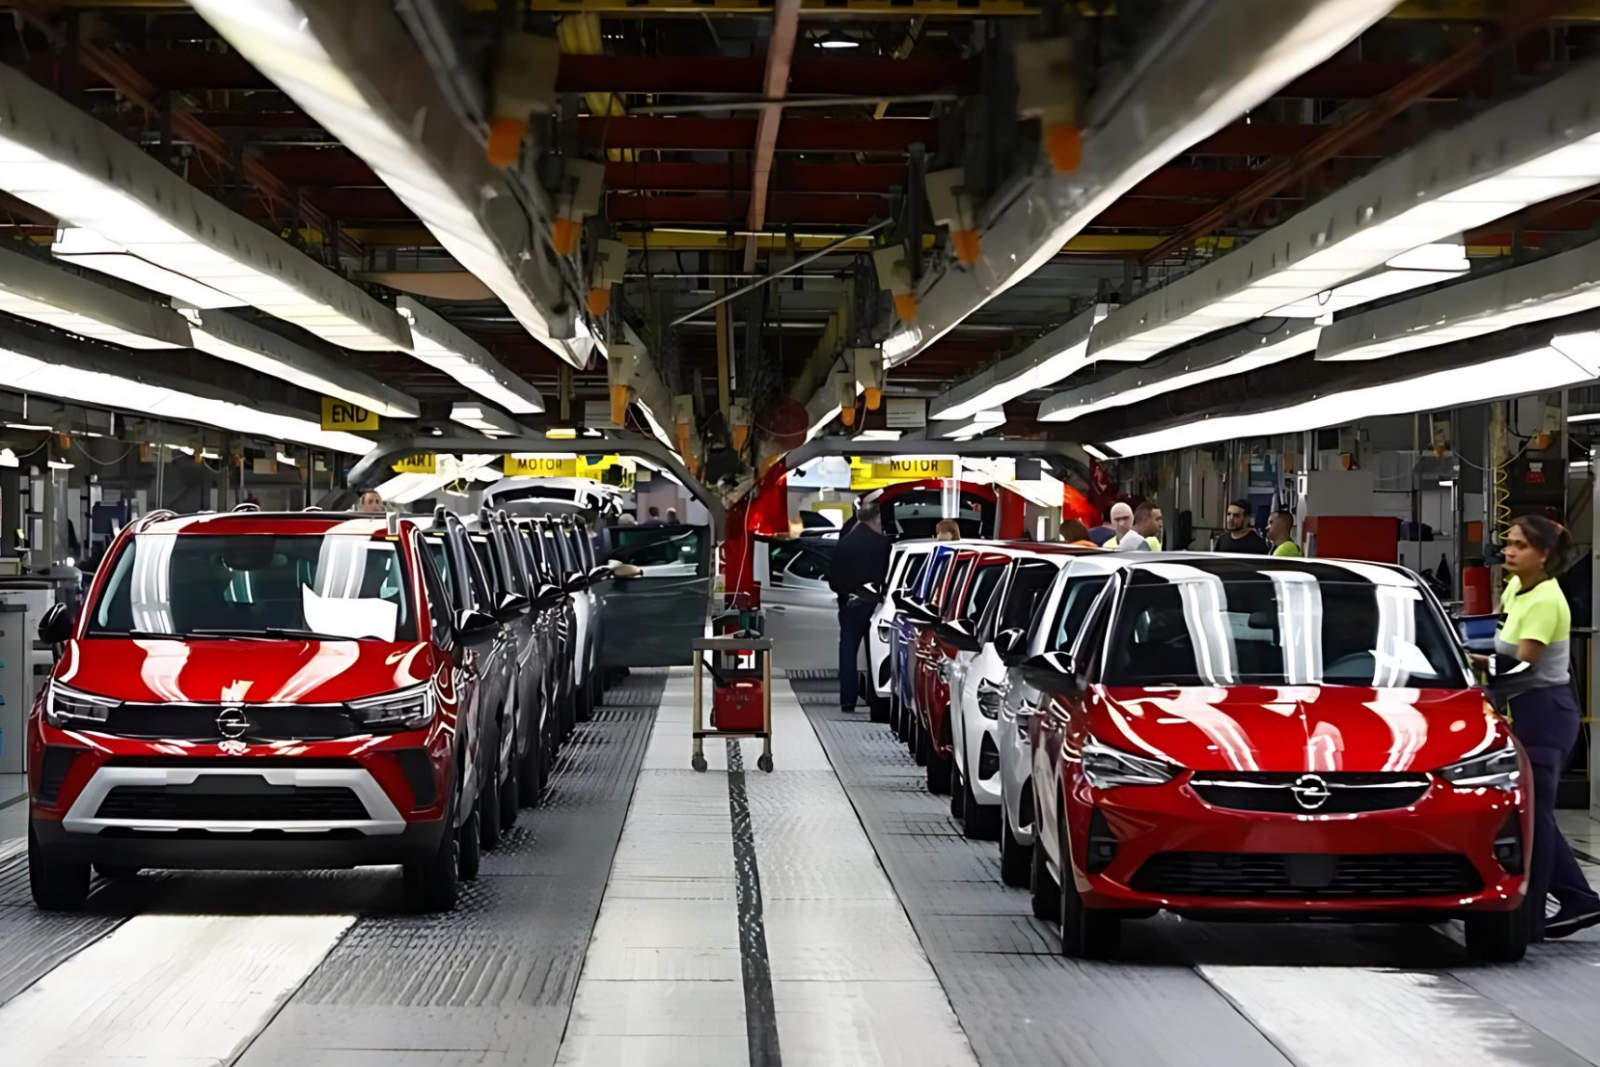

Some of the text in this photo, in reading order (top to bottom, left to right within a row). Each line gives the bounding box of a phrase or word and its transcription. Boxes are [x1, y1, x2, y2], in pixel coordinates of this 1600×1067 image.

[332, 404, 368, 423] END
[517, 458, 562, 470] MOTOR
[890, 459, 939, 472] MOTOR
